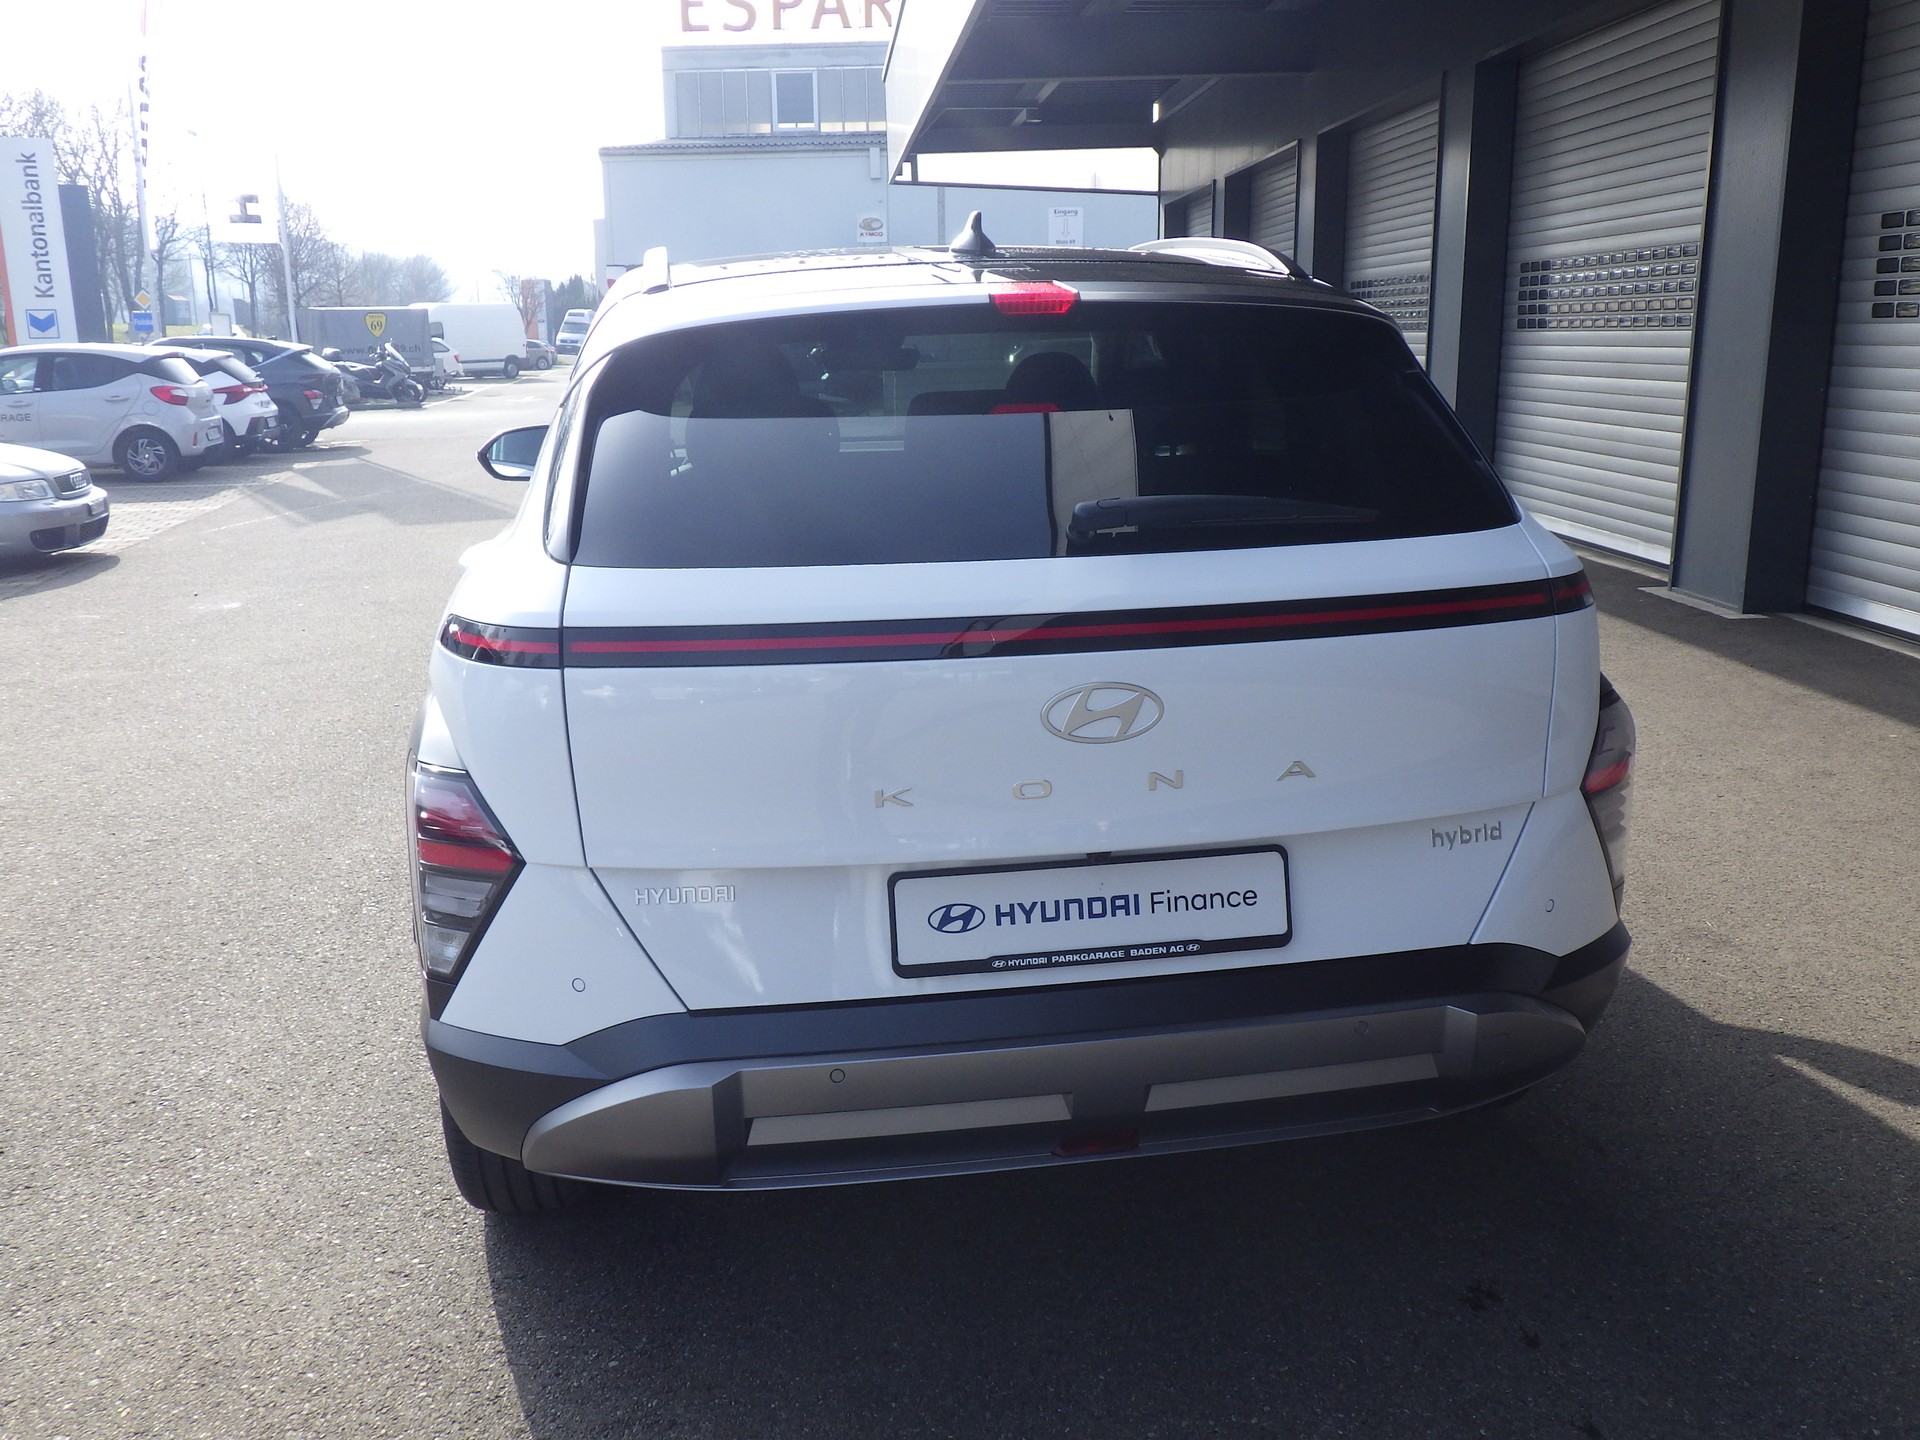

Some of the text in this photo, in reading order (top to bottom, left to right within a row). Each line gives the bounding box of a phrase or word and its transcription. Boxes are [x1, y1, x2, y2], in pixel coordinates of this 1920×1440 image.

[15, 152, 55, 298] Kantonalbank
[370, 320, 383, 331] 69
[0, 413, 32, 422] RAGE
[1430, 820, 1502, 850] hybrid
[634, 884, 736, 905] HYUNDAI
[995, 889, 1258, 926] HYUNDAI Finance
[1008, 945, 1185, 967] HYUNDAI PARKGARAGE BADEN AG
